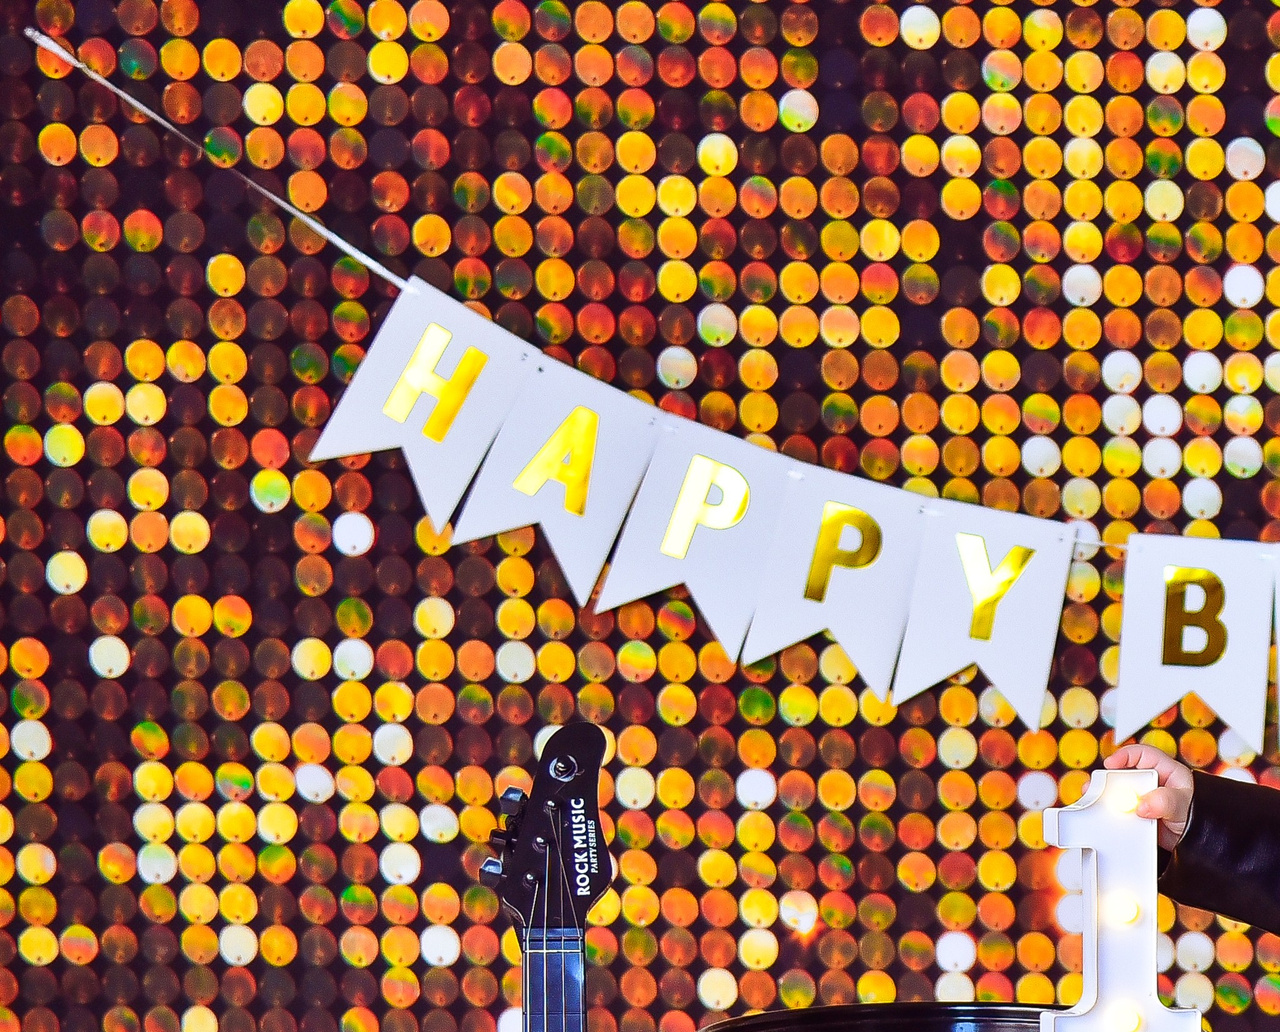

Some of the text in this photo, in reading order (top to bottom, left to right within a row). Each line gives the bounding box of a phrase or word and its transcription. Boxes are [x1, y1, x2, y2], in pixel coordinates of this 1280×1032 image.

[382, 322, 1036, 641] HAPPY
[570, 797, 591, 896] ROCK MUSIC
[587, 819, 599, 874] PARTY SERIES
